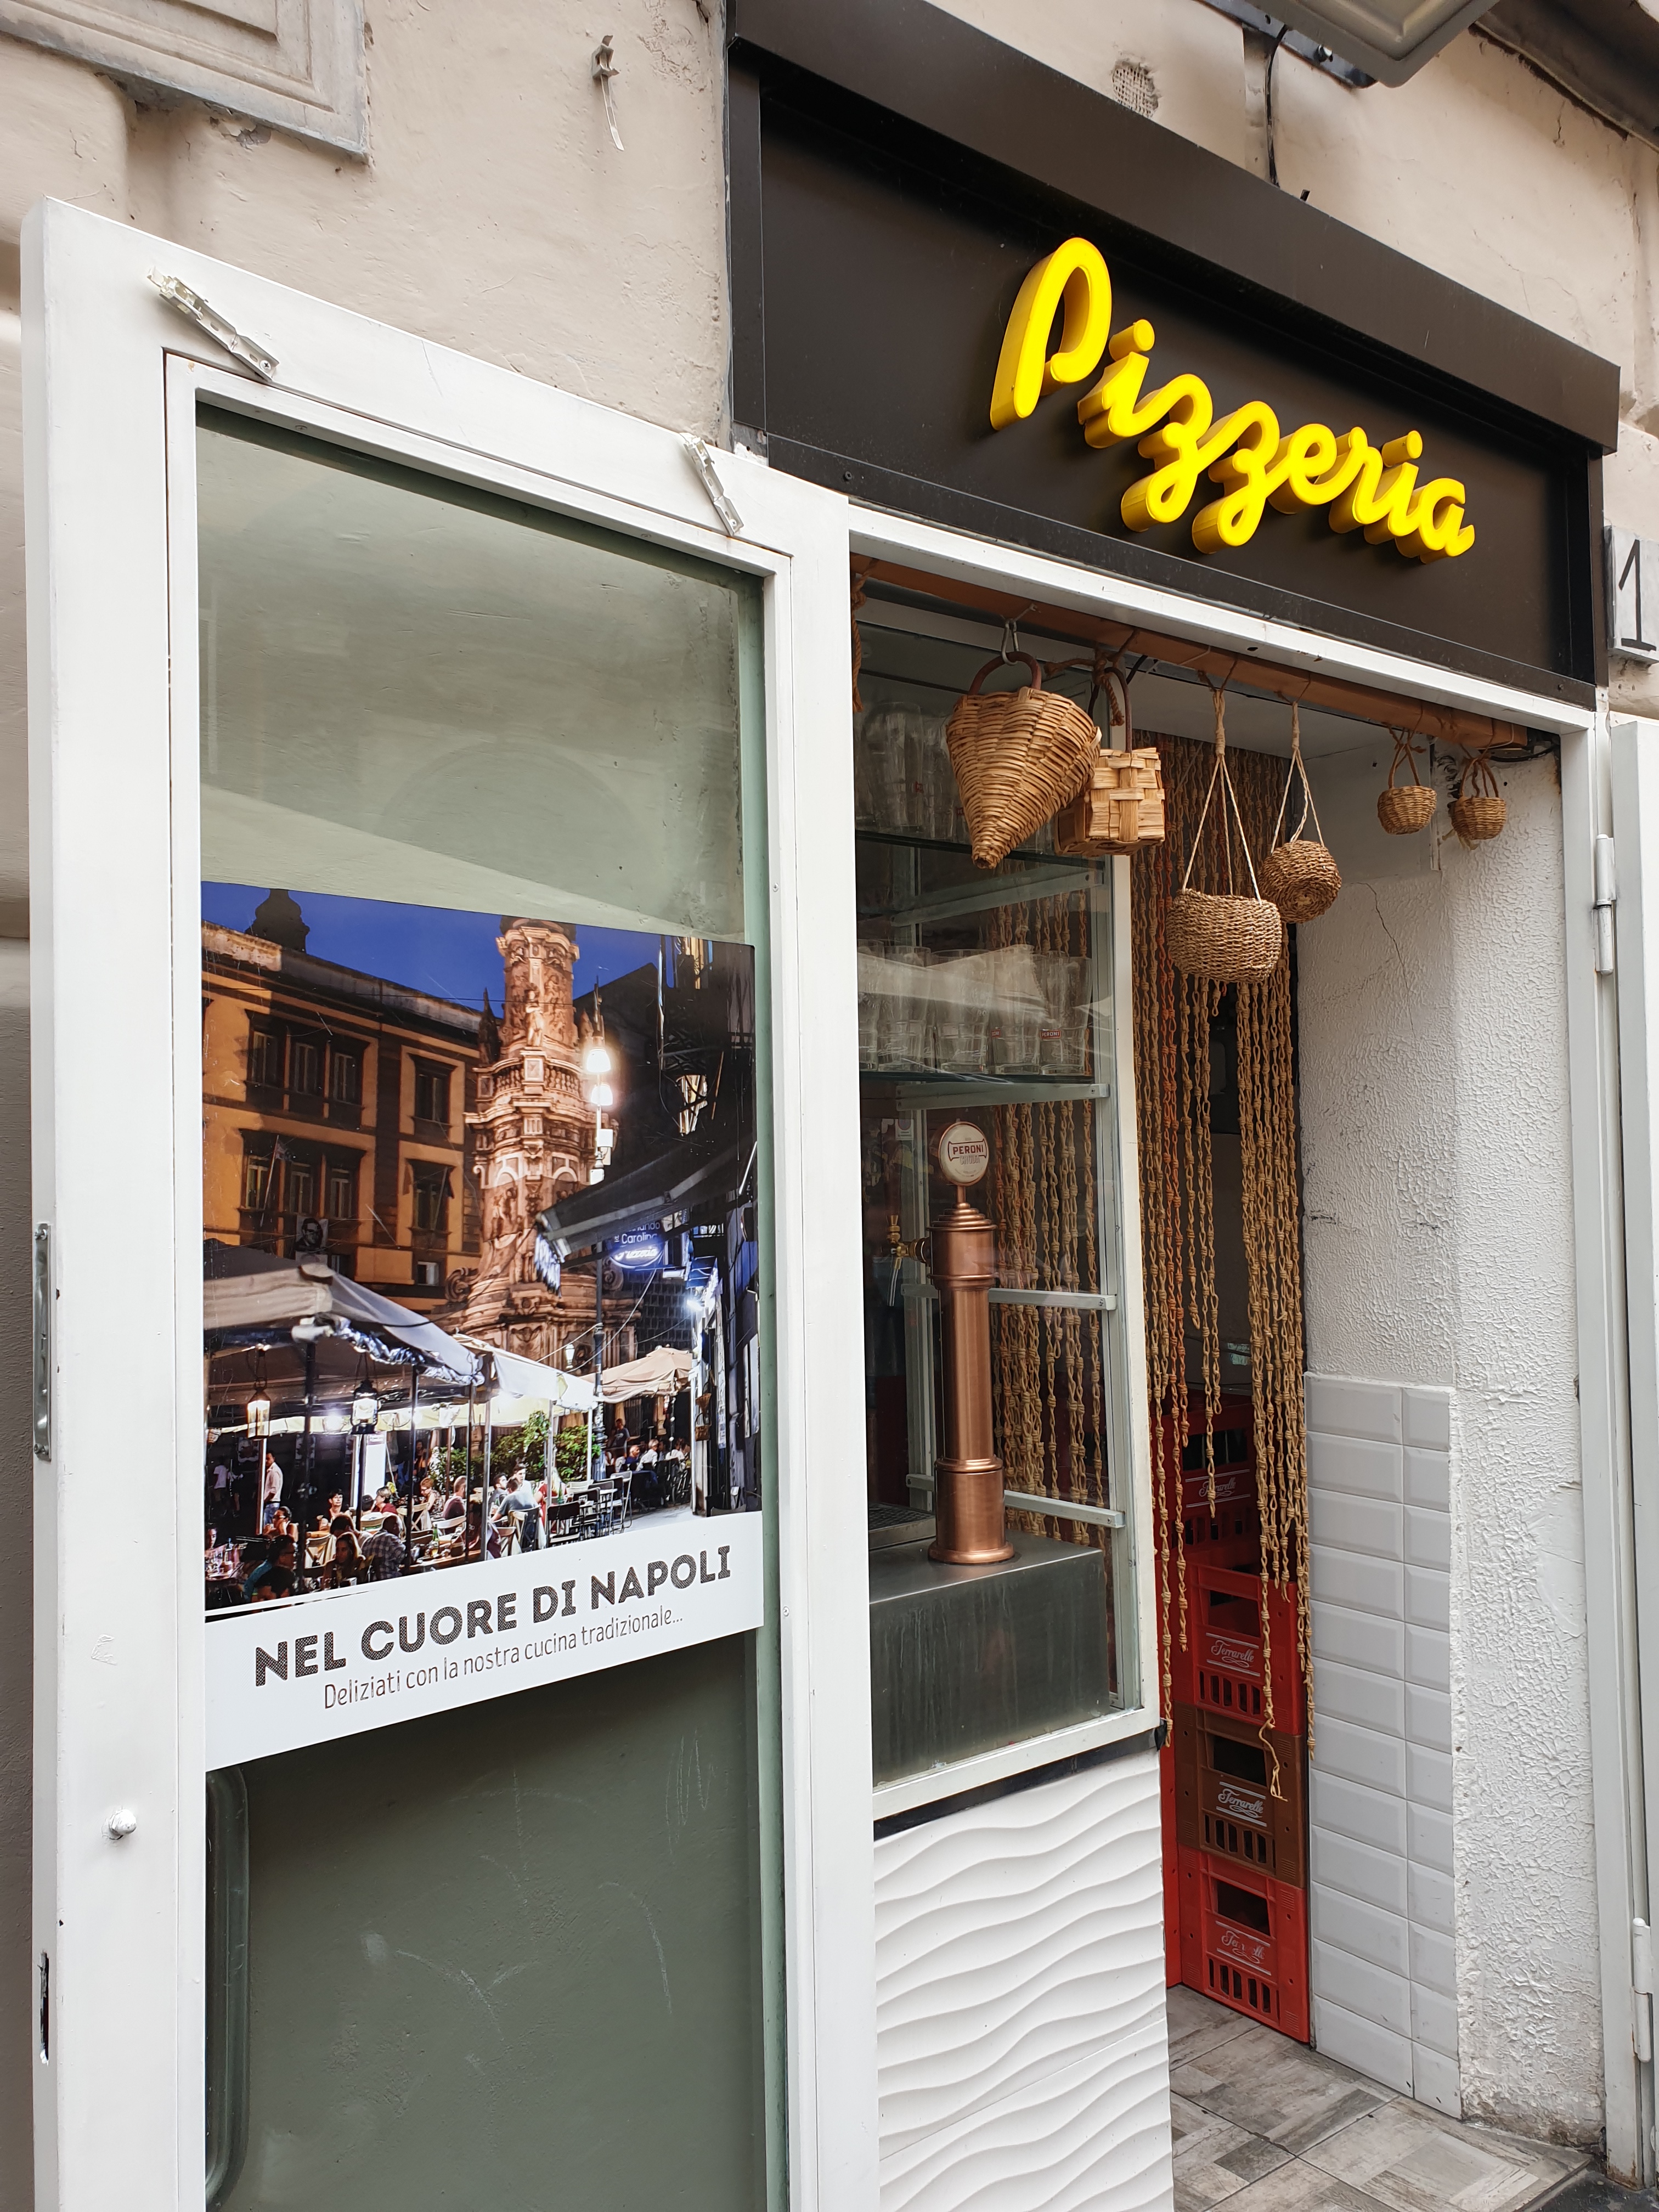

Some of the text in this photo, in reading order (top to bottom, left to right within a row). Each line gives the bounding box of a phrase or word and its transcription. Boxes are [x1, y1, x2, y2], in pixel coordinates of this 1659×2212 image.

[990, 238, 1474, 563] Pizzeria
[1618, 539, 1656, 651] 1
[953, 1144, 984, 1155] PERONI
[256, 1545, 731, 1686] NEL CUORE DI NAPOLI
[325, 1605, 683, 1709] Deliziati con la nostra cucina tradizionale...
